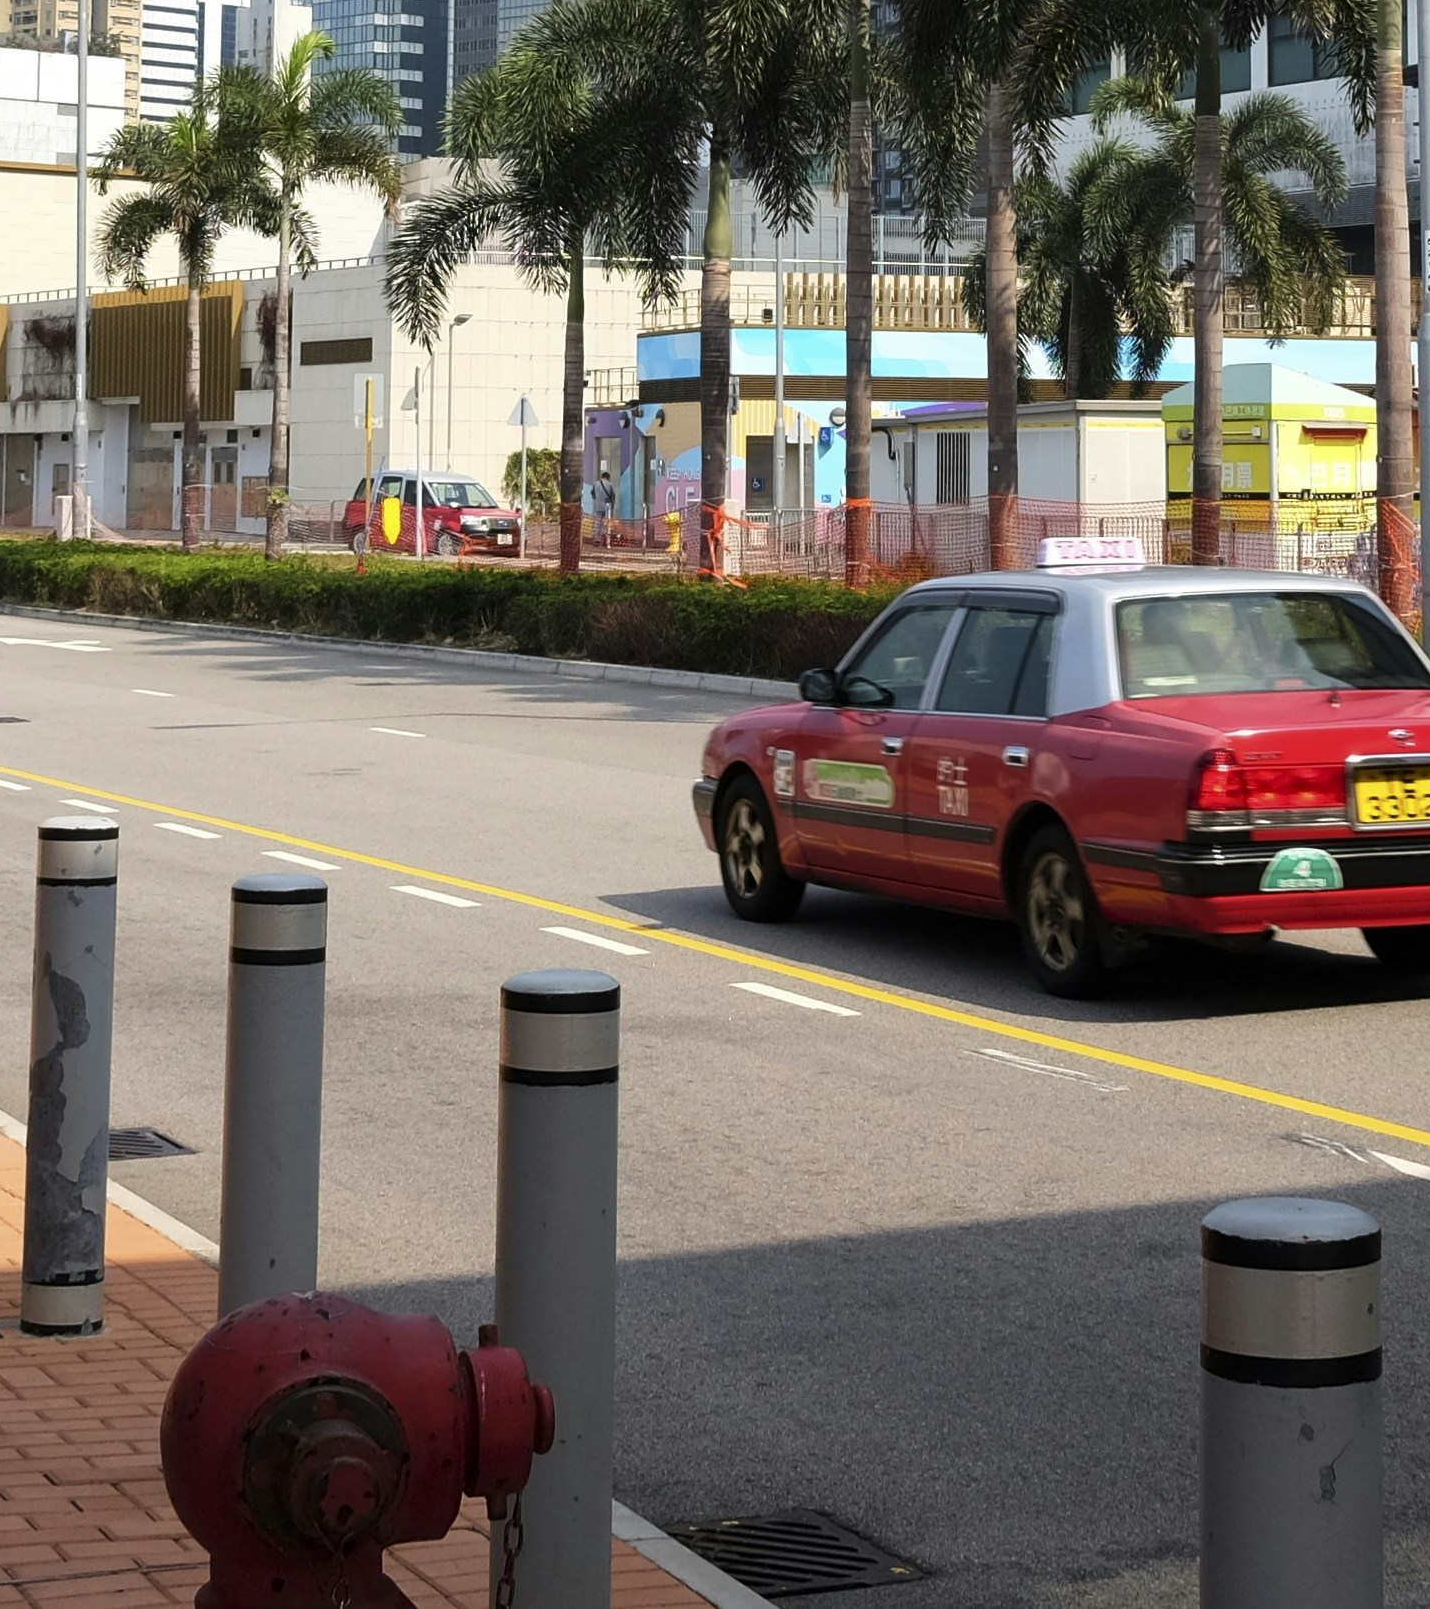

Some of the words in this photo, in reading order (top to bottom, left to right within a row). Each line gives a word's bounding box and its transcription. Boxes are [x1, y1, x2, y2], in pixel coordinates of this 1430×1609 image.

[1055, 540, 1136, 559] TAXI
[936, 757, 969, 785] 的士
[936, 786, 969, 816] TAXI
[1293, 860, 1312, 878] 4
